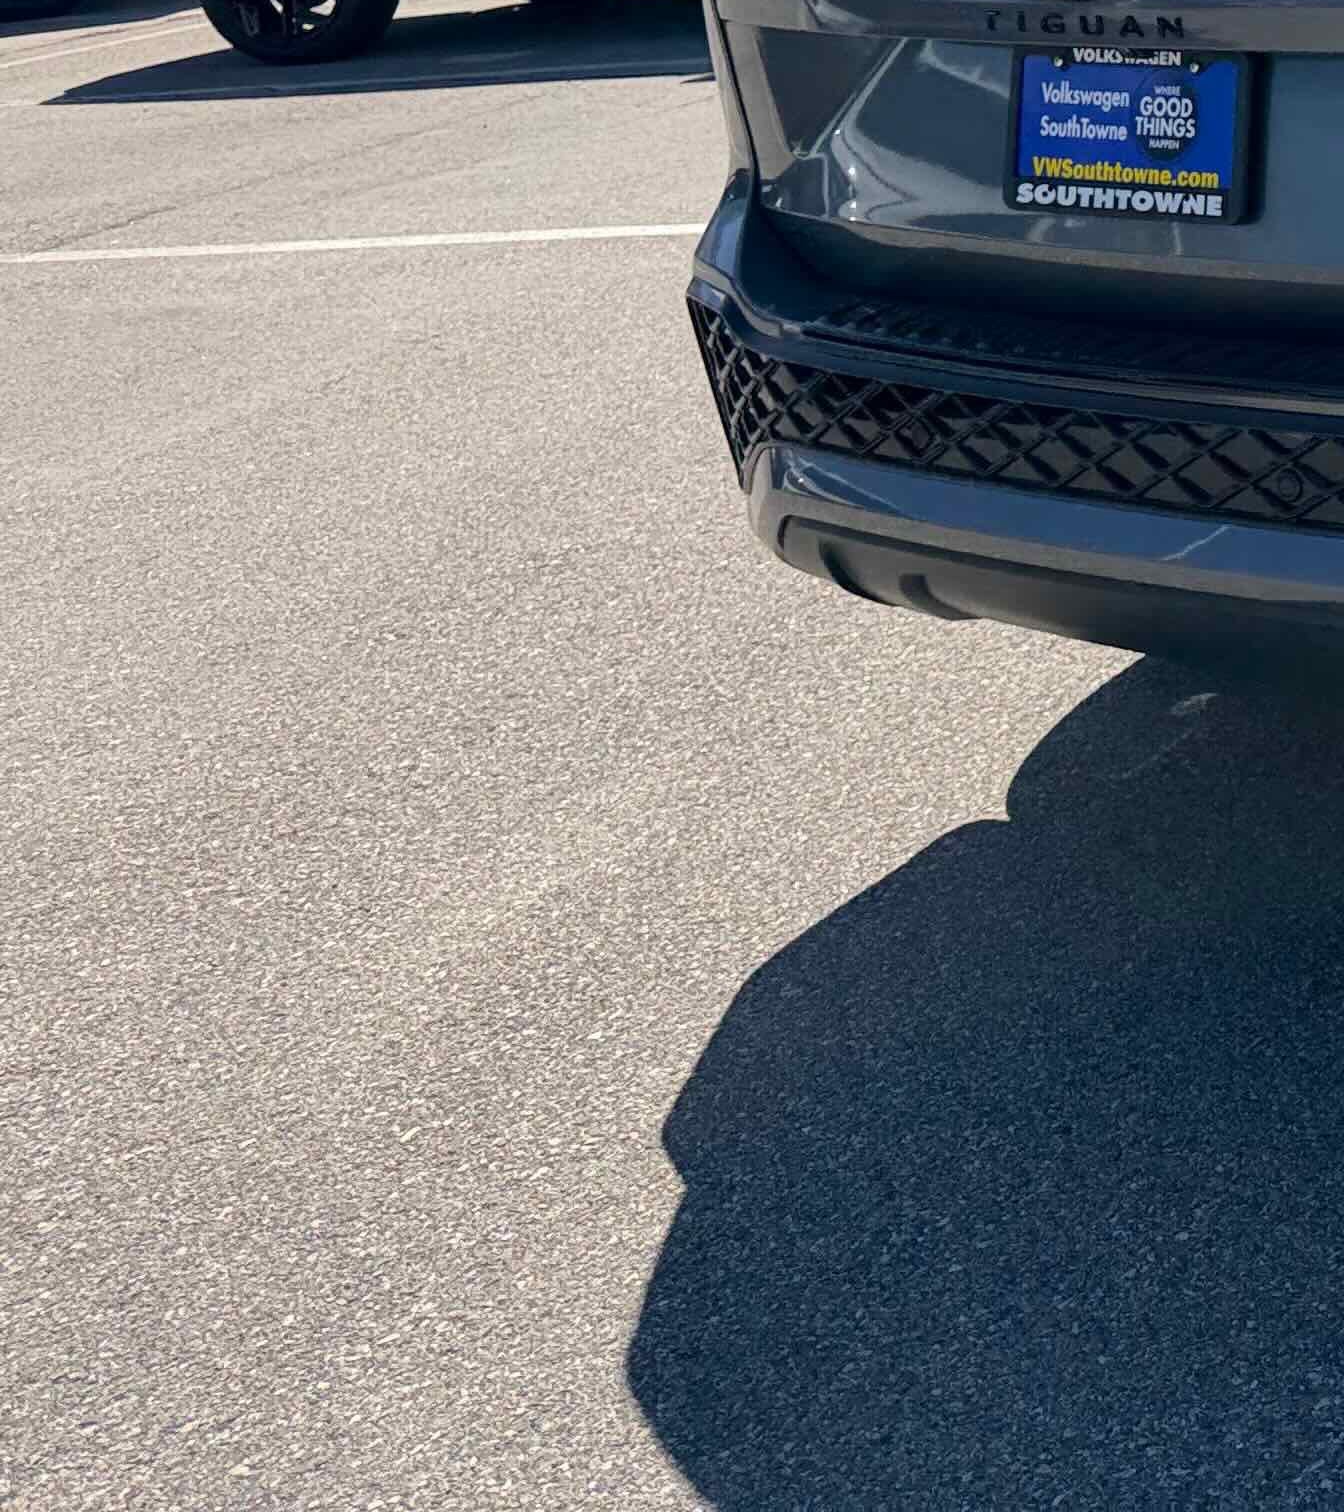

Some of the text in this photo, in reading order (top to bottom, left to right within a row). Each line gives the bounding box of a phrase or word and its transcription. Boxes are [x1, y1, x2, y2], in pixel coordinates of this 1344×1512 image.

[984, 9, 1185, 39] TIGUAN
[1041, 80, 1130, 112] Volkswagen
[1140, 96, 1193, 117] GOOD
[1040, 114, 1128, 141] SouthTowne
[1136, 116, 1196, 138] THINGS
[1148, 139, 1180, 150] HAPPEN
[1032, 155, 1219, 188] VWSouthtowne.com
[1015, 182, 1223, 217] SOUTHTOWNE
